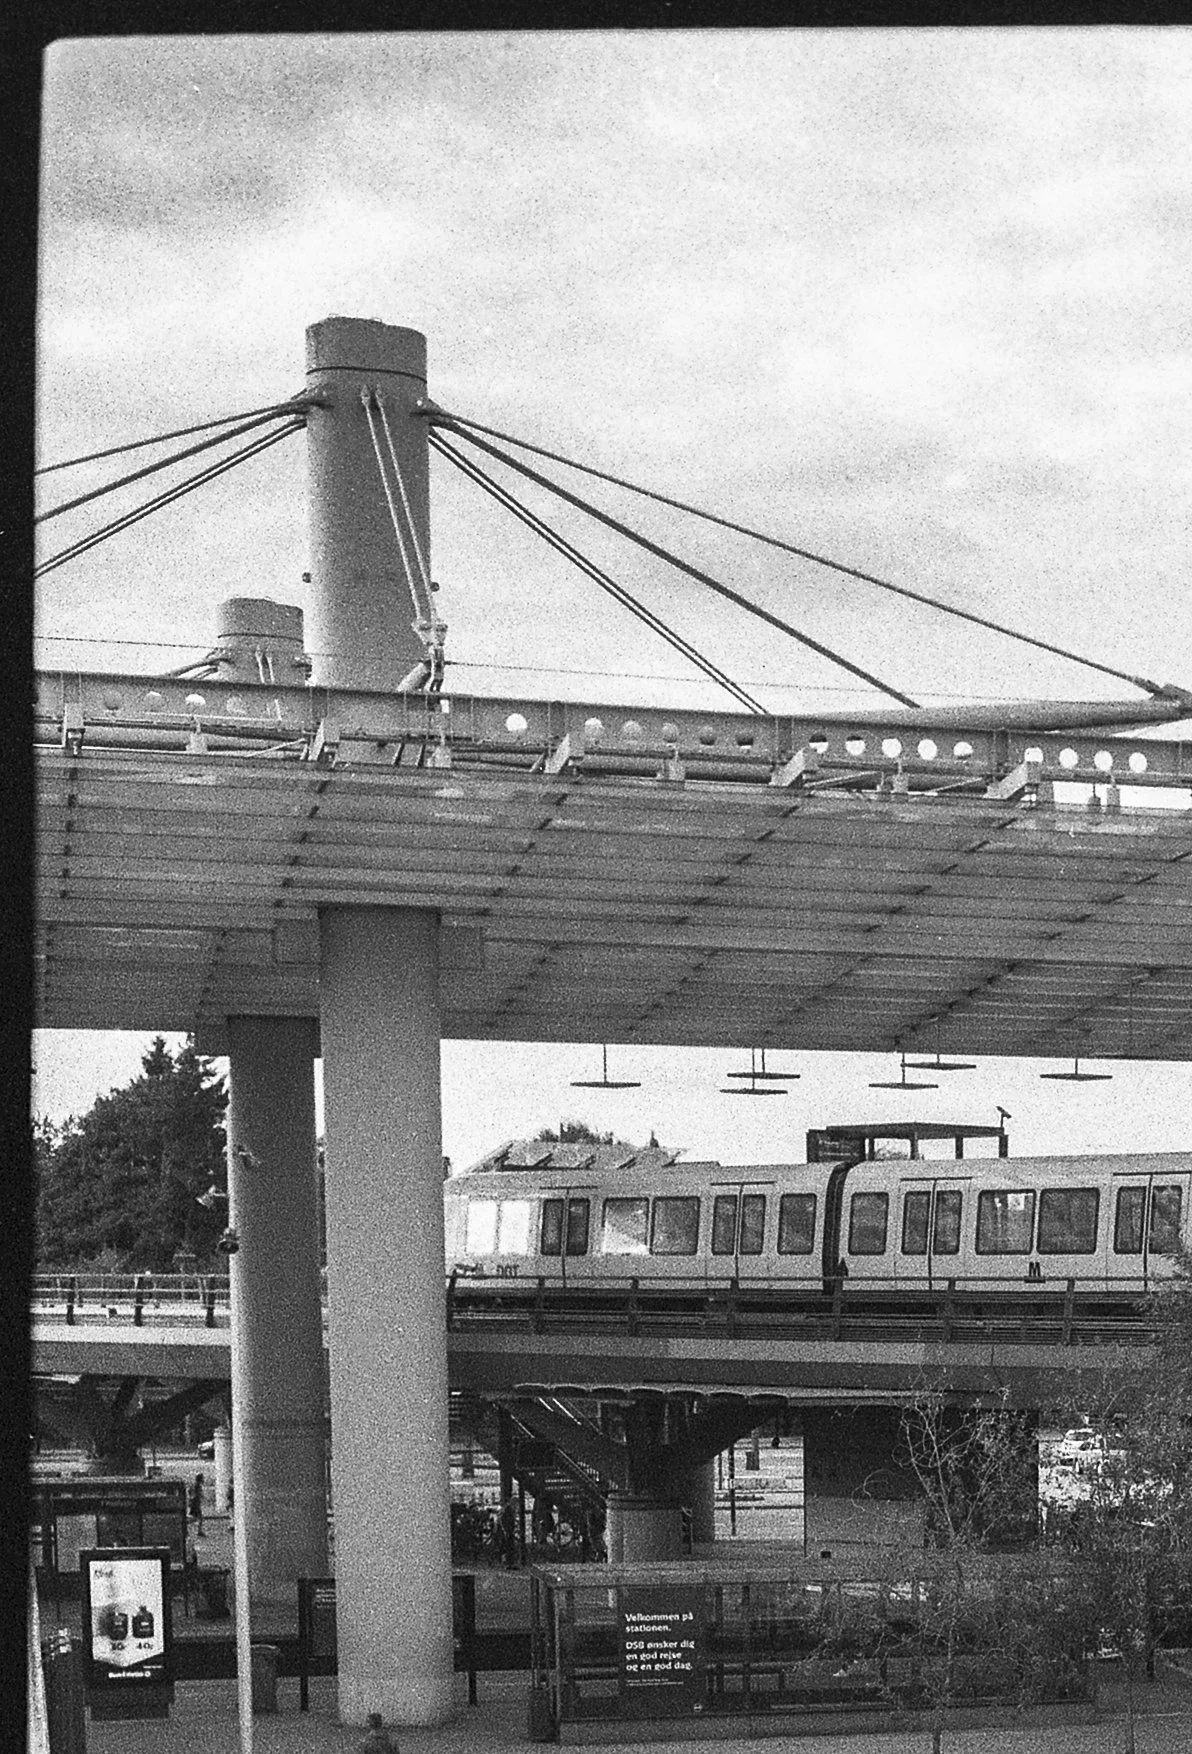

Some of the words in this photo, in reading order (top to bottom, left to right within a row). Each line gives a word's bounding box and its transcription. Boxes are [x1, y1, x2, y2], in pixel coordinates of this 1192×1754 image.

[625, 1613, 680, 1622] Velkommen
[682, 1612, 694, 1622] på
[626, 1625, 671, 1633] stationen.
[626, 1641, 645, 1650] DSB
[647, 1641, 678, 1649] ønsker
[680, 1640, 695, 1649] dig
[626, 1653, 638, 1661] en
[640, 1652, 658, 1661] god
[660, 1651, 682, 1660] rejse
[626, 1663, 638, 1672] og
[640, 1663, 652, 1671] en
[654, 1661, 672, 1671] god
